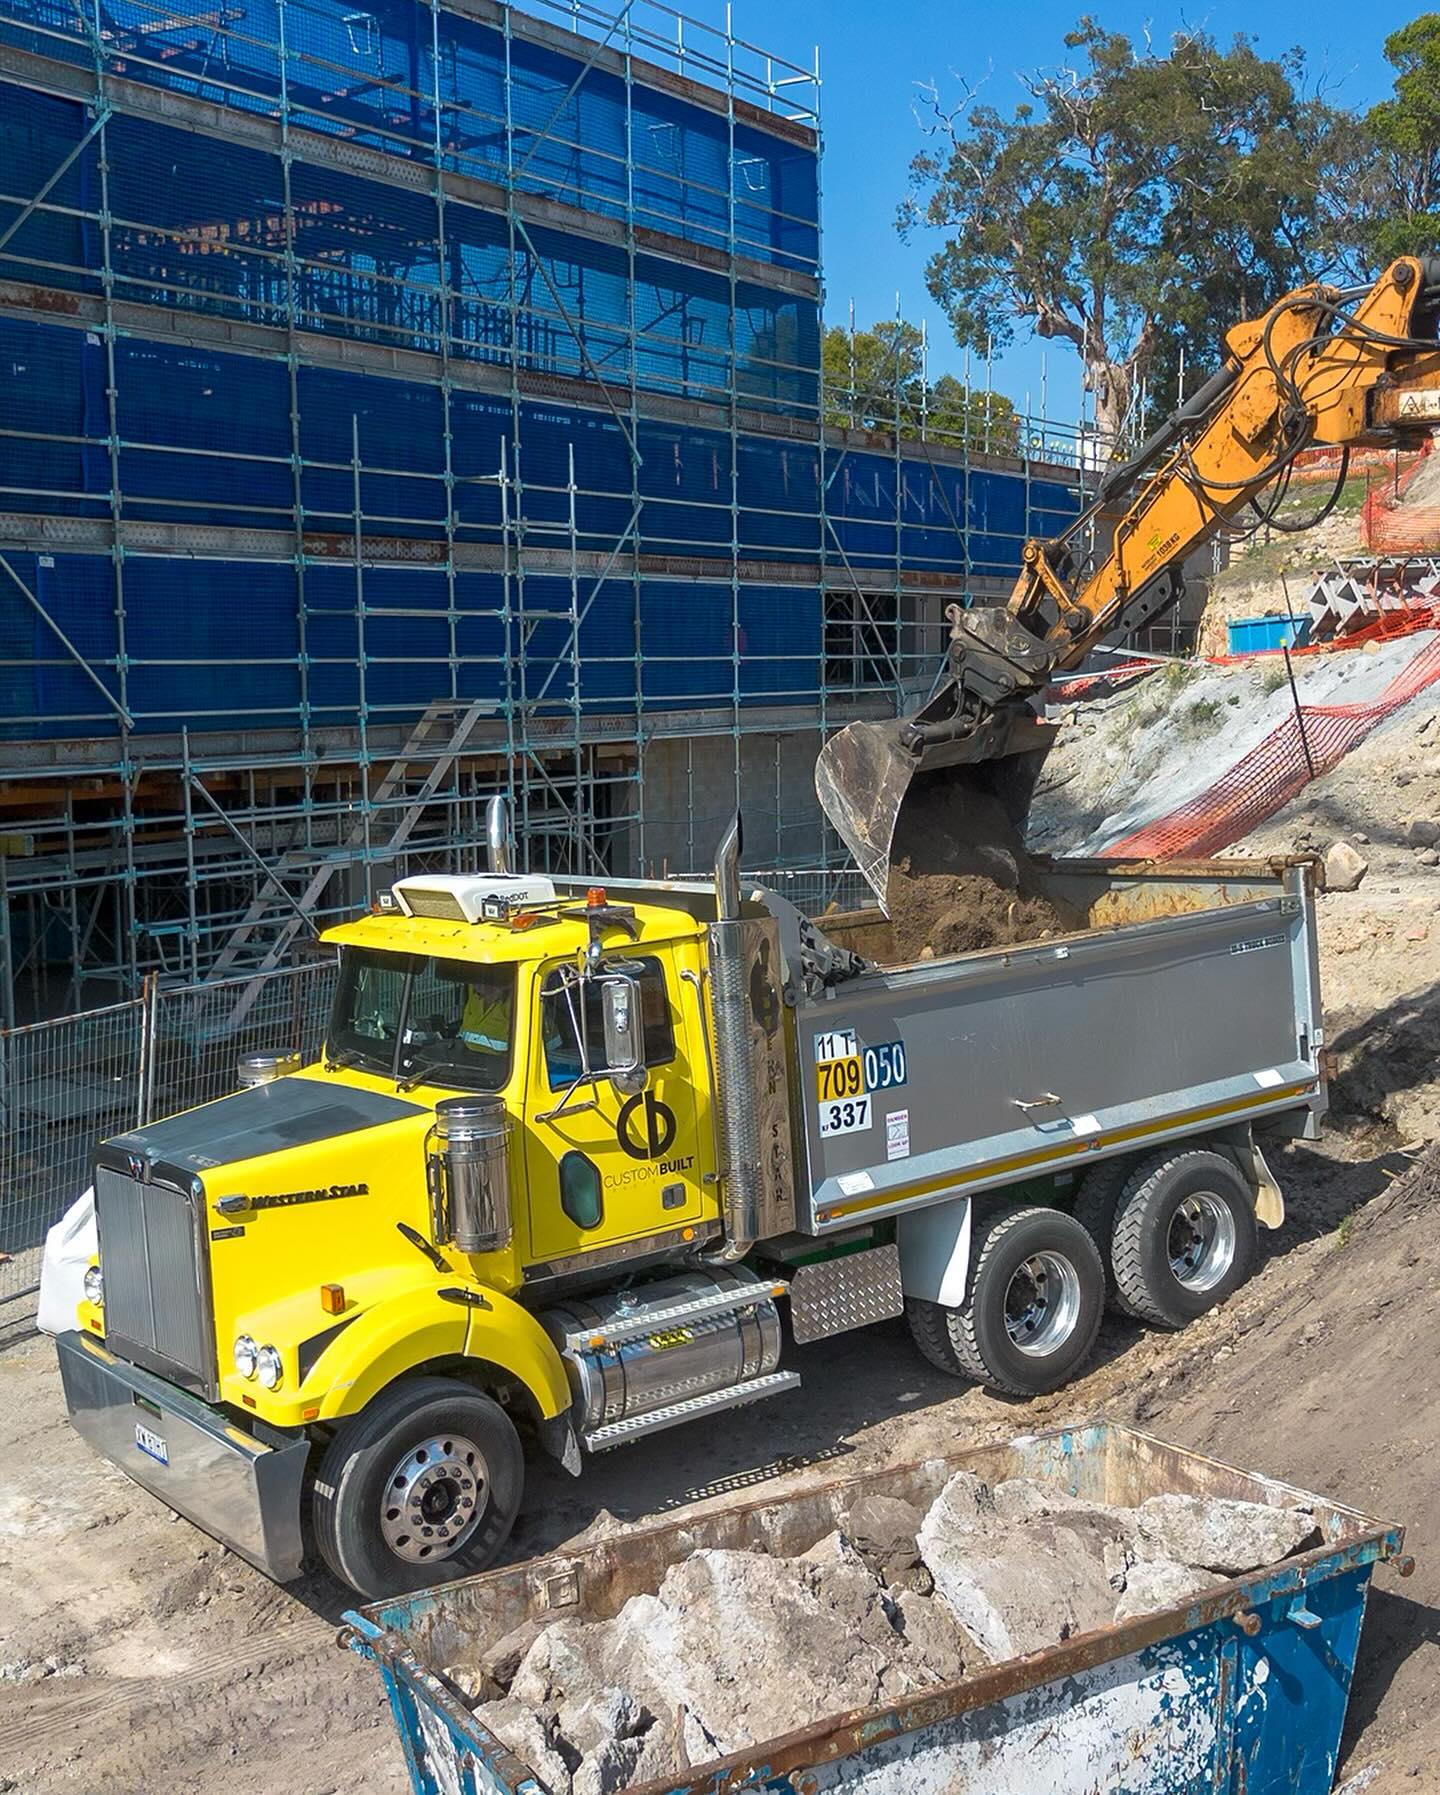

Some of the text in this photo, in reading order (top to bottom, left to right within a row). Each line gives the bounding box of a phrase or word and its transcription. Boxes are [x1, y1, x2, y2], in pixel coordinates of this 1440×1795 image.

[817, 1034, 835, 1059] 11
[819, 1060, 860, 1099] 709
[865, 1044, 905, 1089] 050
[829, 1101, 867, 1130] 337
